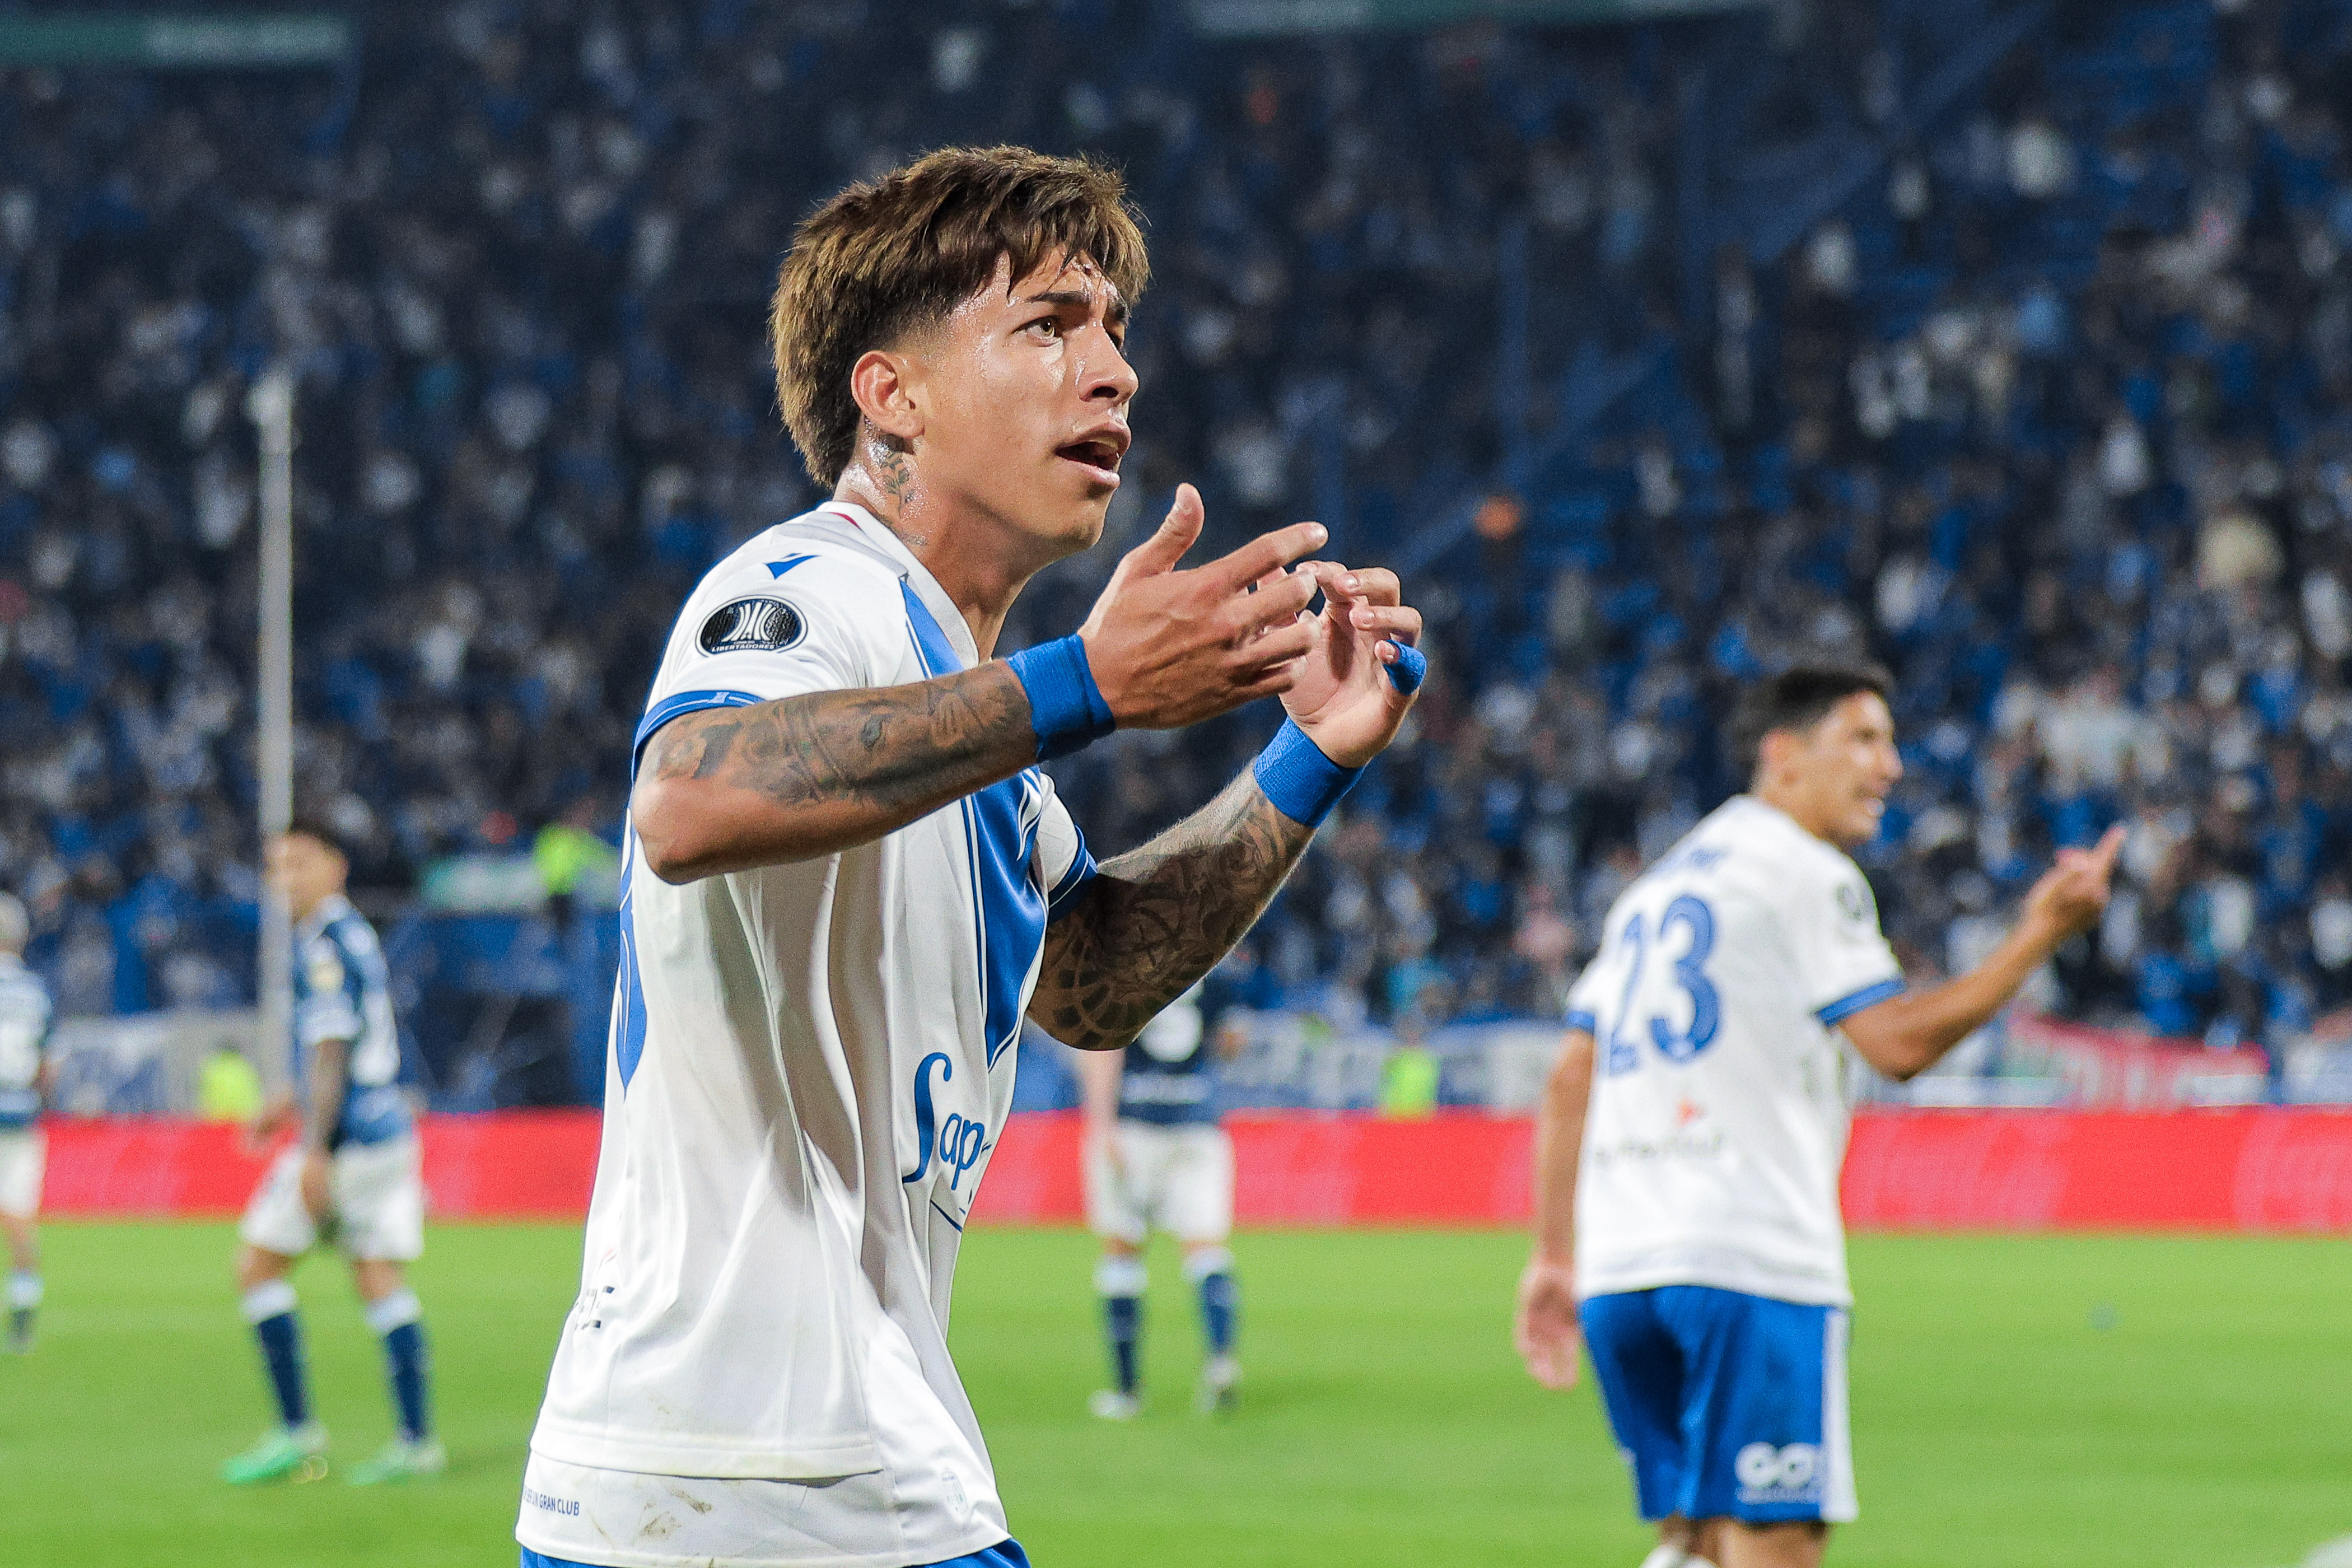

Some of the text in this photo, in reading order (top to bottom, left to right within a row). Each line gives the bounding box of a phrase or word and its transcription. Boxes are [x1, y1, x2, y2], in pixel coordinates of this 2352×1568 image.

[711, 644, 775, 652] LIBERTADORES
[1598, 895, 1719, 1077] 23
[902, 1052, 992, 1191] Sap
[539, 1494, 556, 1512] GRAN
[557, 1499, 580, 1516] CLUB
